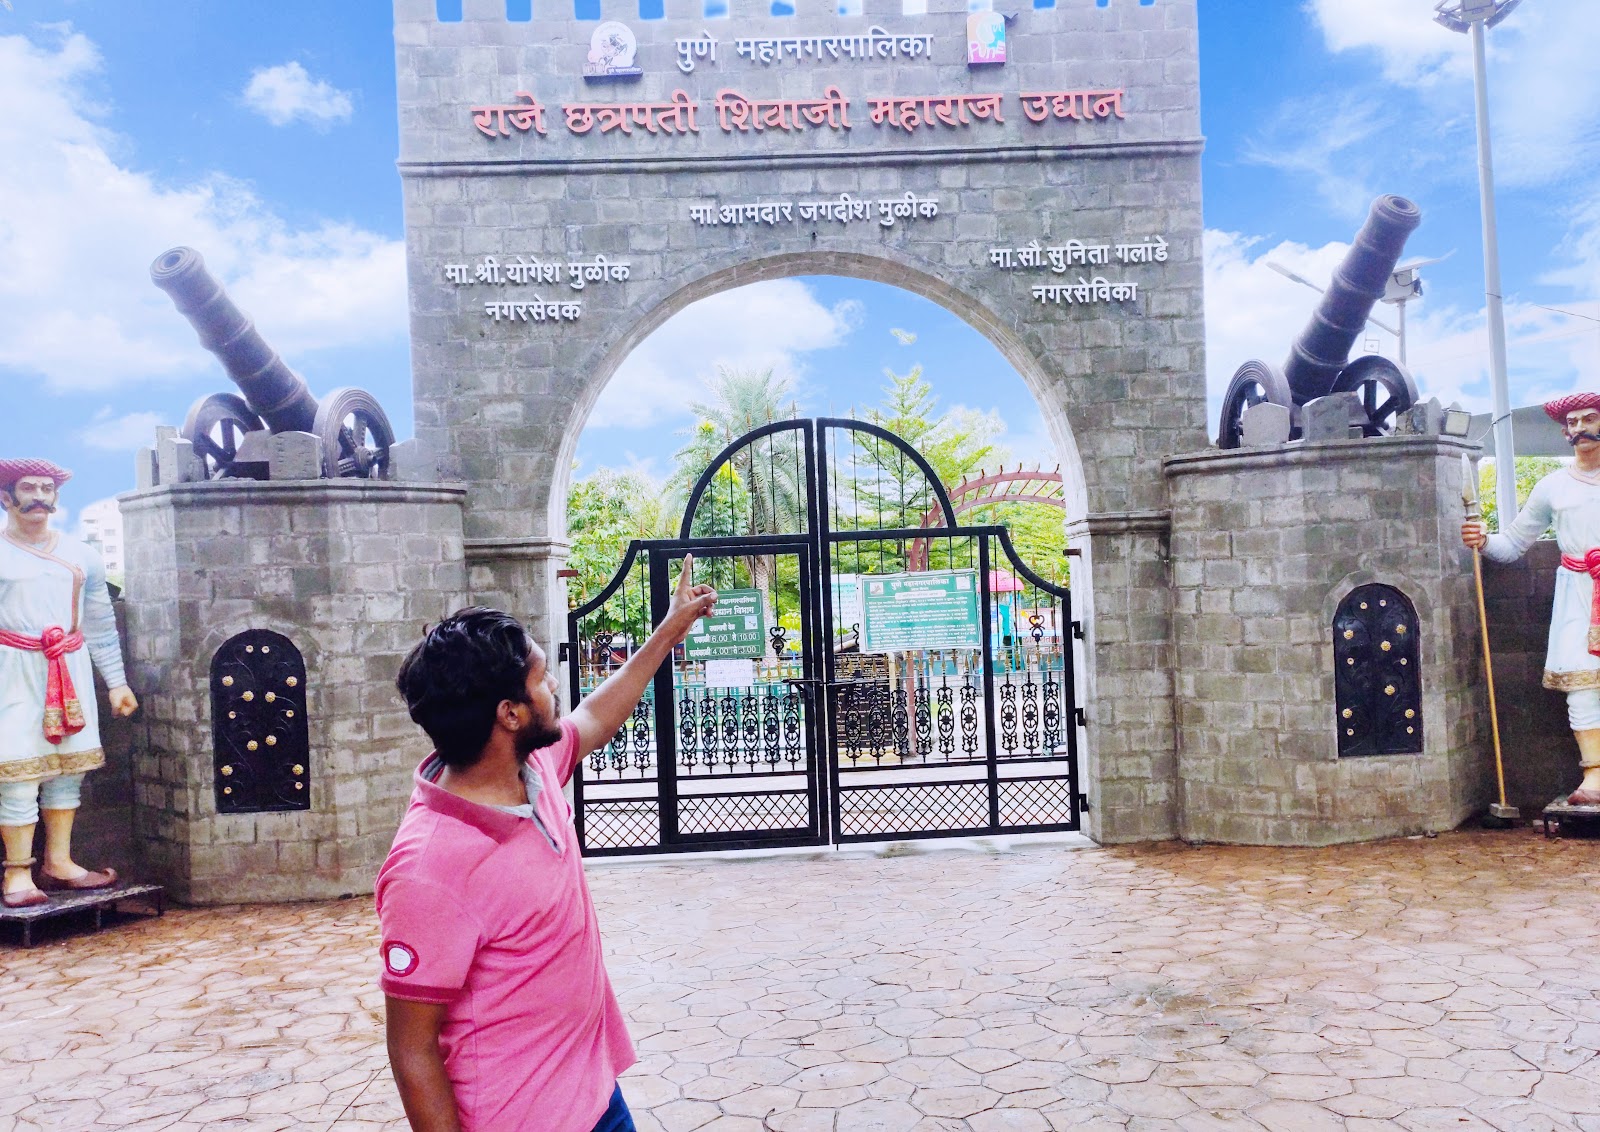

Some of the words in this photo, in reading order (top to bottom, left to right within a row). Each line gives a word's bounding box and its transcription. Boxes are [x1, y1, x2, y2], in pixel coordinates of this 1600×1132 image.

[675, 30, 719, 73] पुणे
[735, 24, 934, 64] महानगरपालिका
[471, 92, 547, 137] राजे
[563, 89, 699, 134] छत्रपती
[715, 85, 851, 131] शिवाजी
[867, 93, 1004, 131] महाराज
[1019, 86, 1125, 122] उद्यान
[798, 192, 872, 224] जगदीश
[877, 191, 939, 227] मुळीक
[568, 255, 631, 290] मुळीक
[485, 294, 582, 322] नगरसेवक
[1031, 276, 1138, 305] नगरसेविका
